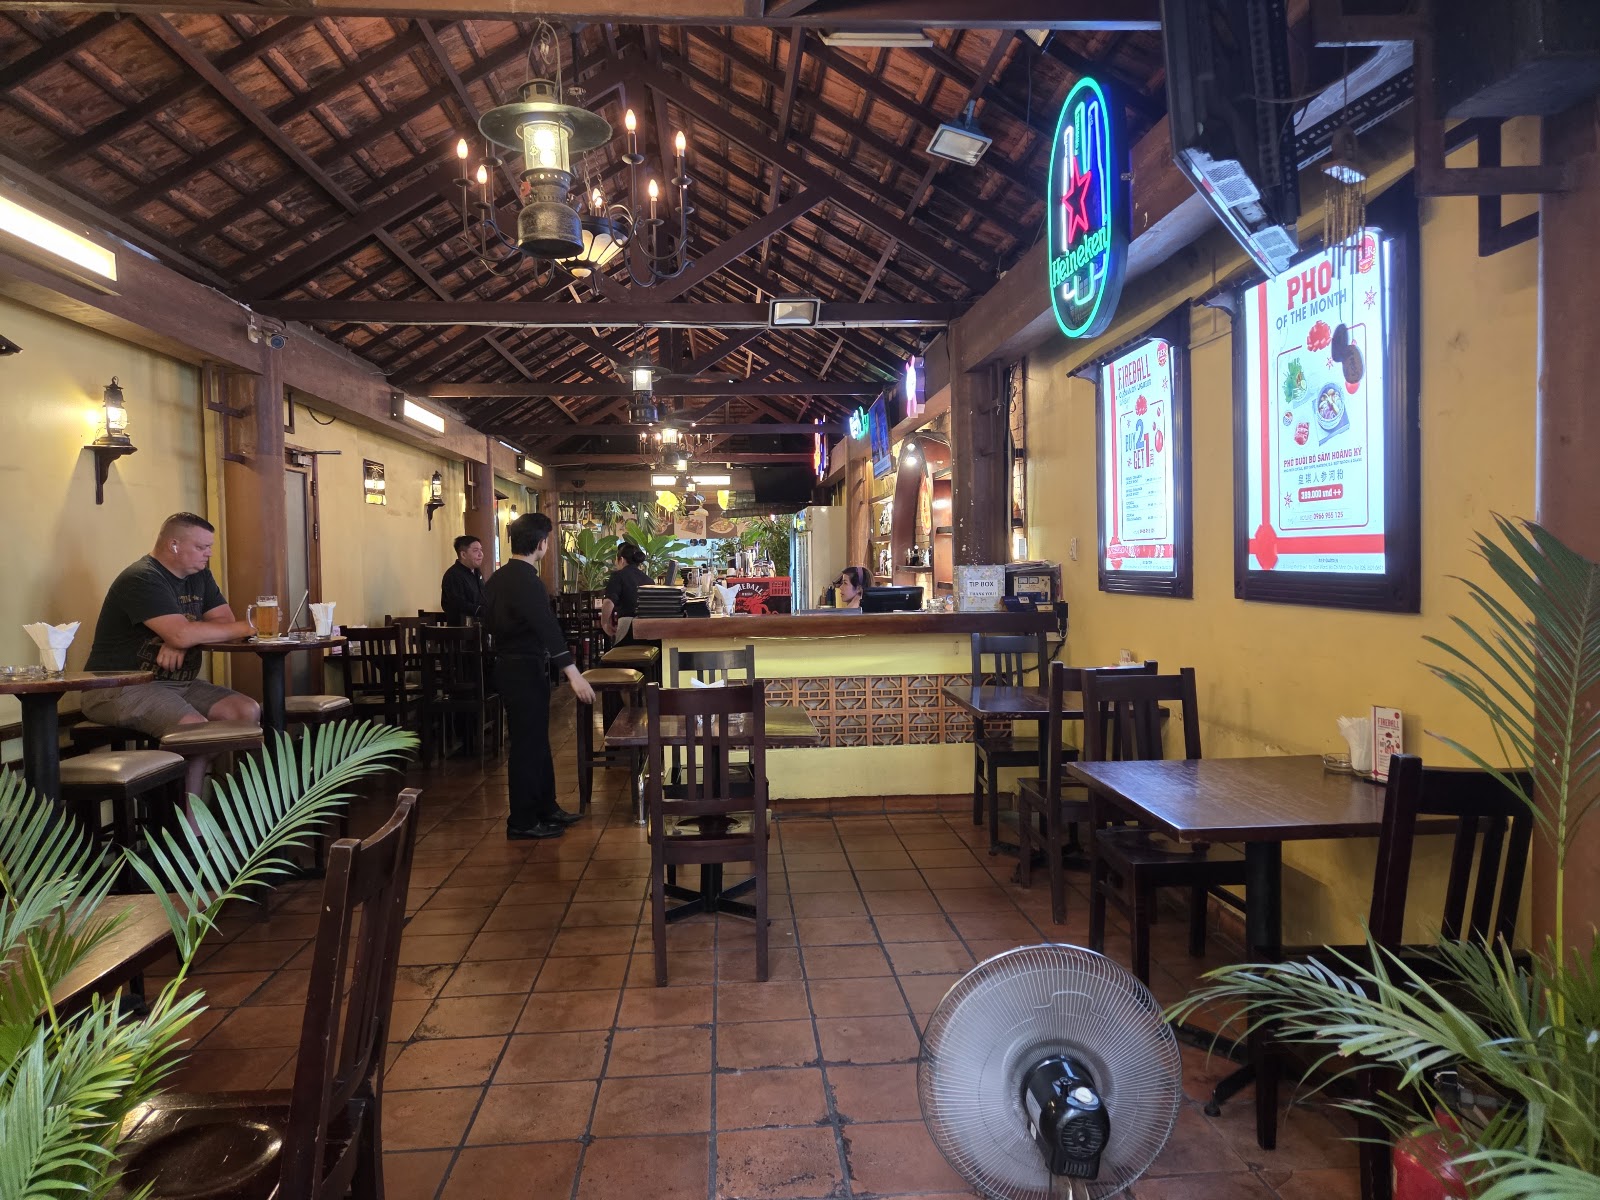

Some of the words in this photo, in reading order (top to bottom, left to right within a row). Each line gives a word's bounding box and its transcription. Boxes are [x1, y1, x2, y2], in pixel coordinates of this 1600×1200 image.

[1052, 227, 1107, 288] Heineken
[1287, 260, 1332, 311] PHO
[1276, 315, 1288, 331] OF
[1290, 308, 1307, 325] THE
[1310, 289, 1346, 316] MONTH
[1118, 354, 1151, 390] FIREBALL
[1133, 448, 1144, 469] GET
[1144, 432, 1150, 468] 1
[1135, 418, 1144, 449] 2
[1378, 717, 1400, 728] FIREBALL
